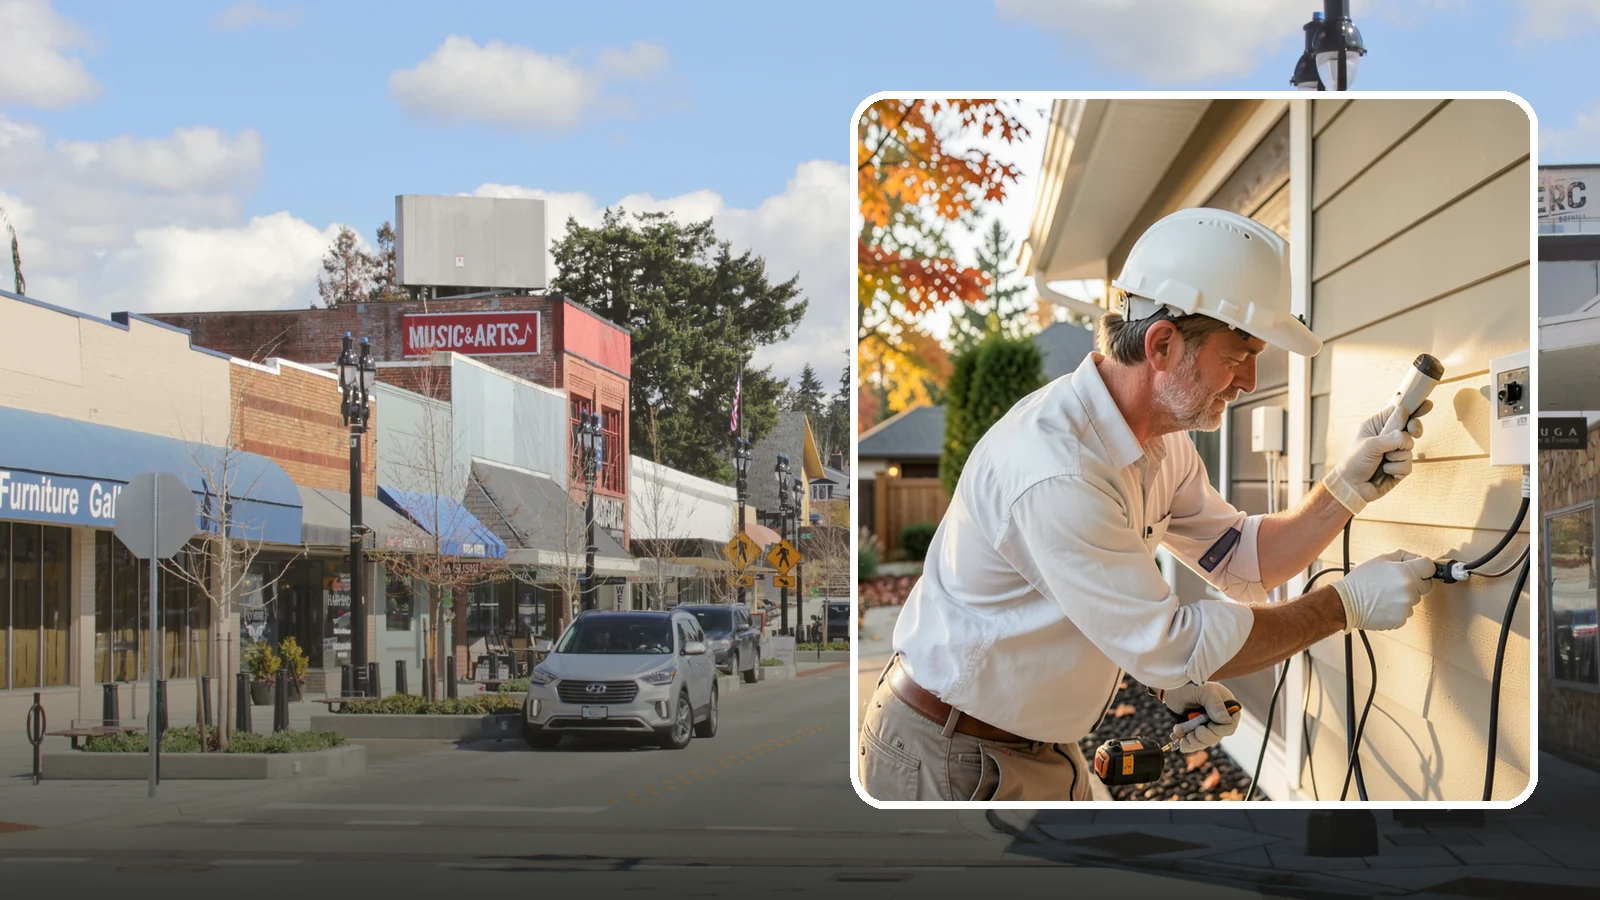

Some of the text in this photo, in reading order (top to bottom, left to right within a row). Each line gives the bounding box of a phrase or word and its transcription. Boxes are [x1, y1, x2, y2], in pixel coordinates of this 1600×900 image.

[408, 322, 519, 348] MUSIC&ARTS
[0, 471, 122, 519] Furniture Gal
[453, 563, 479, 574] SUSHI
